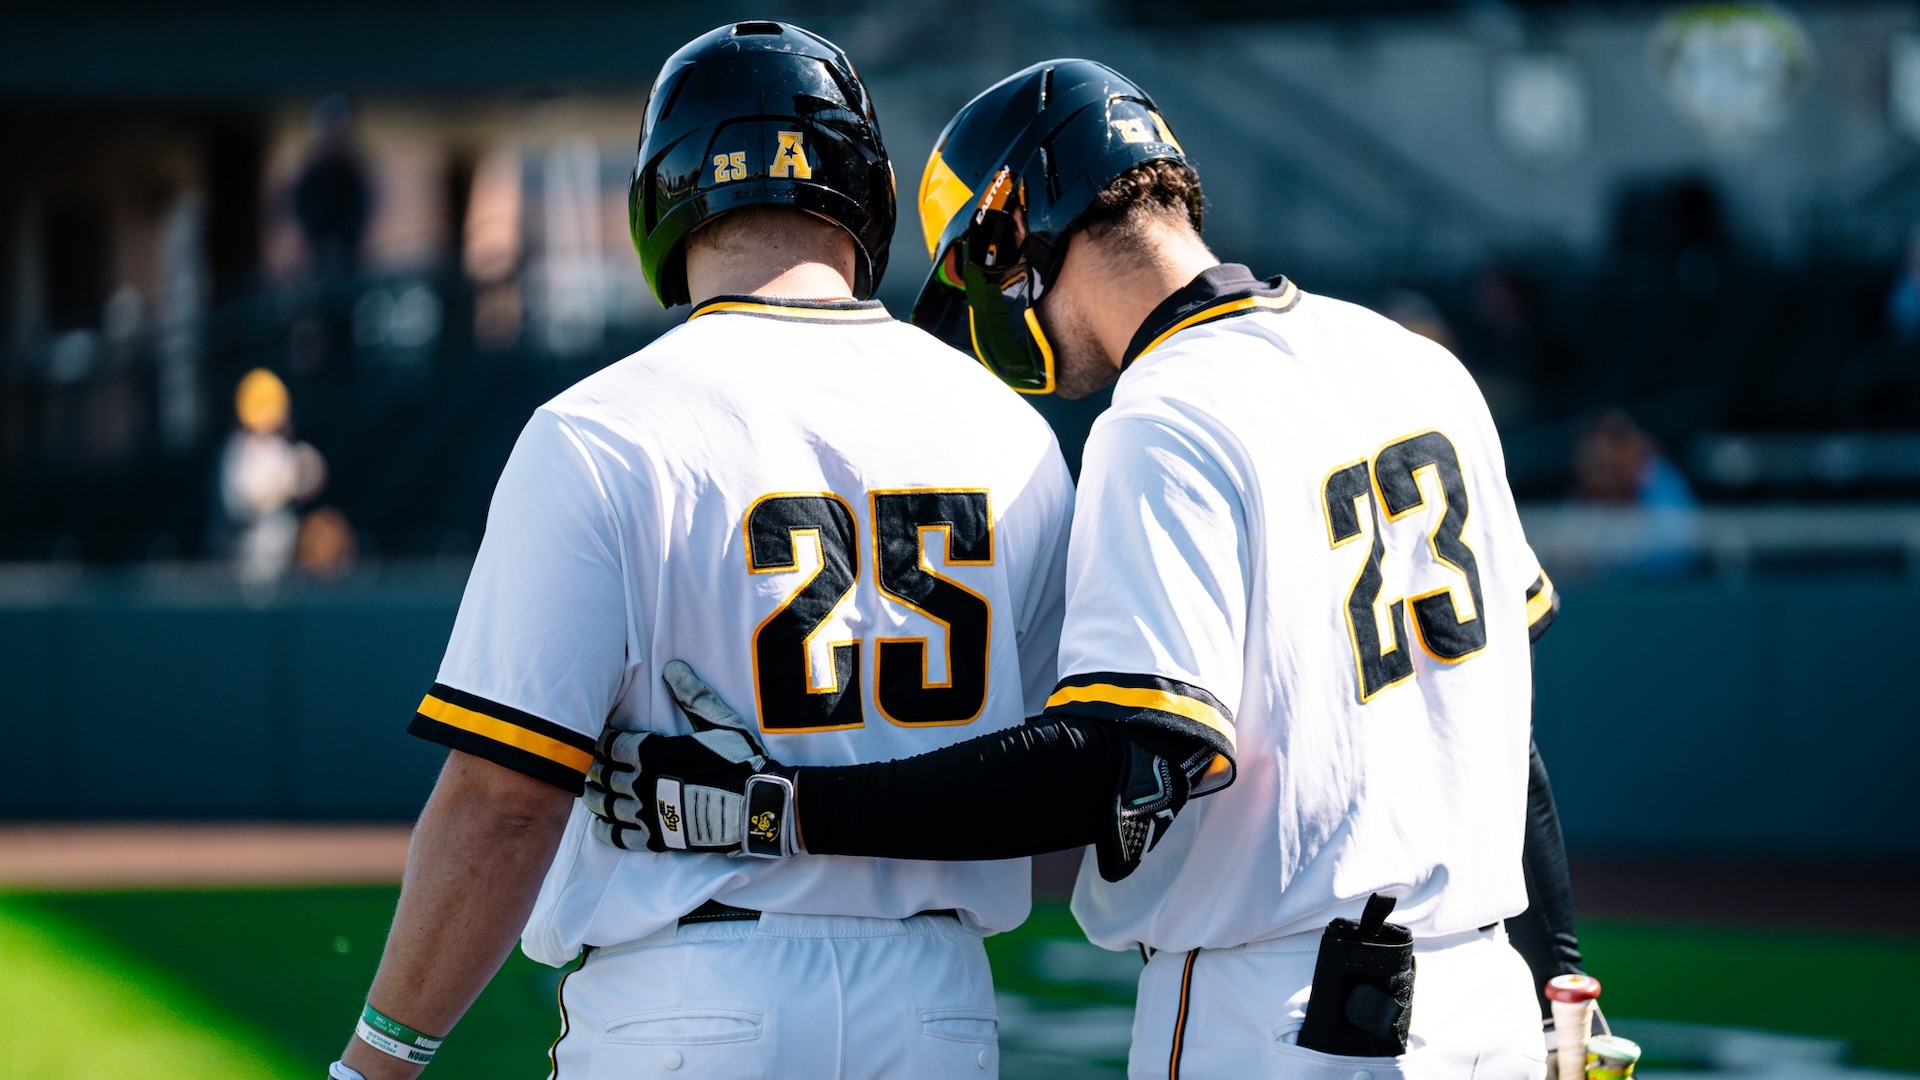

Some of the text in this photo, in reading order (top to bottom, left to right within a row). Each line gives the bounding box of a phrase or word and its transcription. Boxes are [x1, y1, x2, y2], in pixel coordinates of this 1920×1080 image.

[713, 151, 747, 183] 25
[769, 131, 812, 180] A
[975, 164, 1010, 225] EASTON
[1321, 429, 1486, 704] 23
[743, 487, 994, 734] 25
